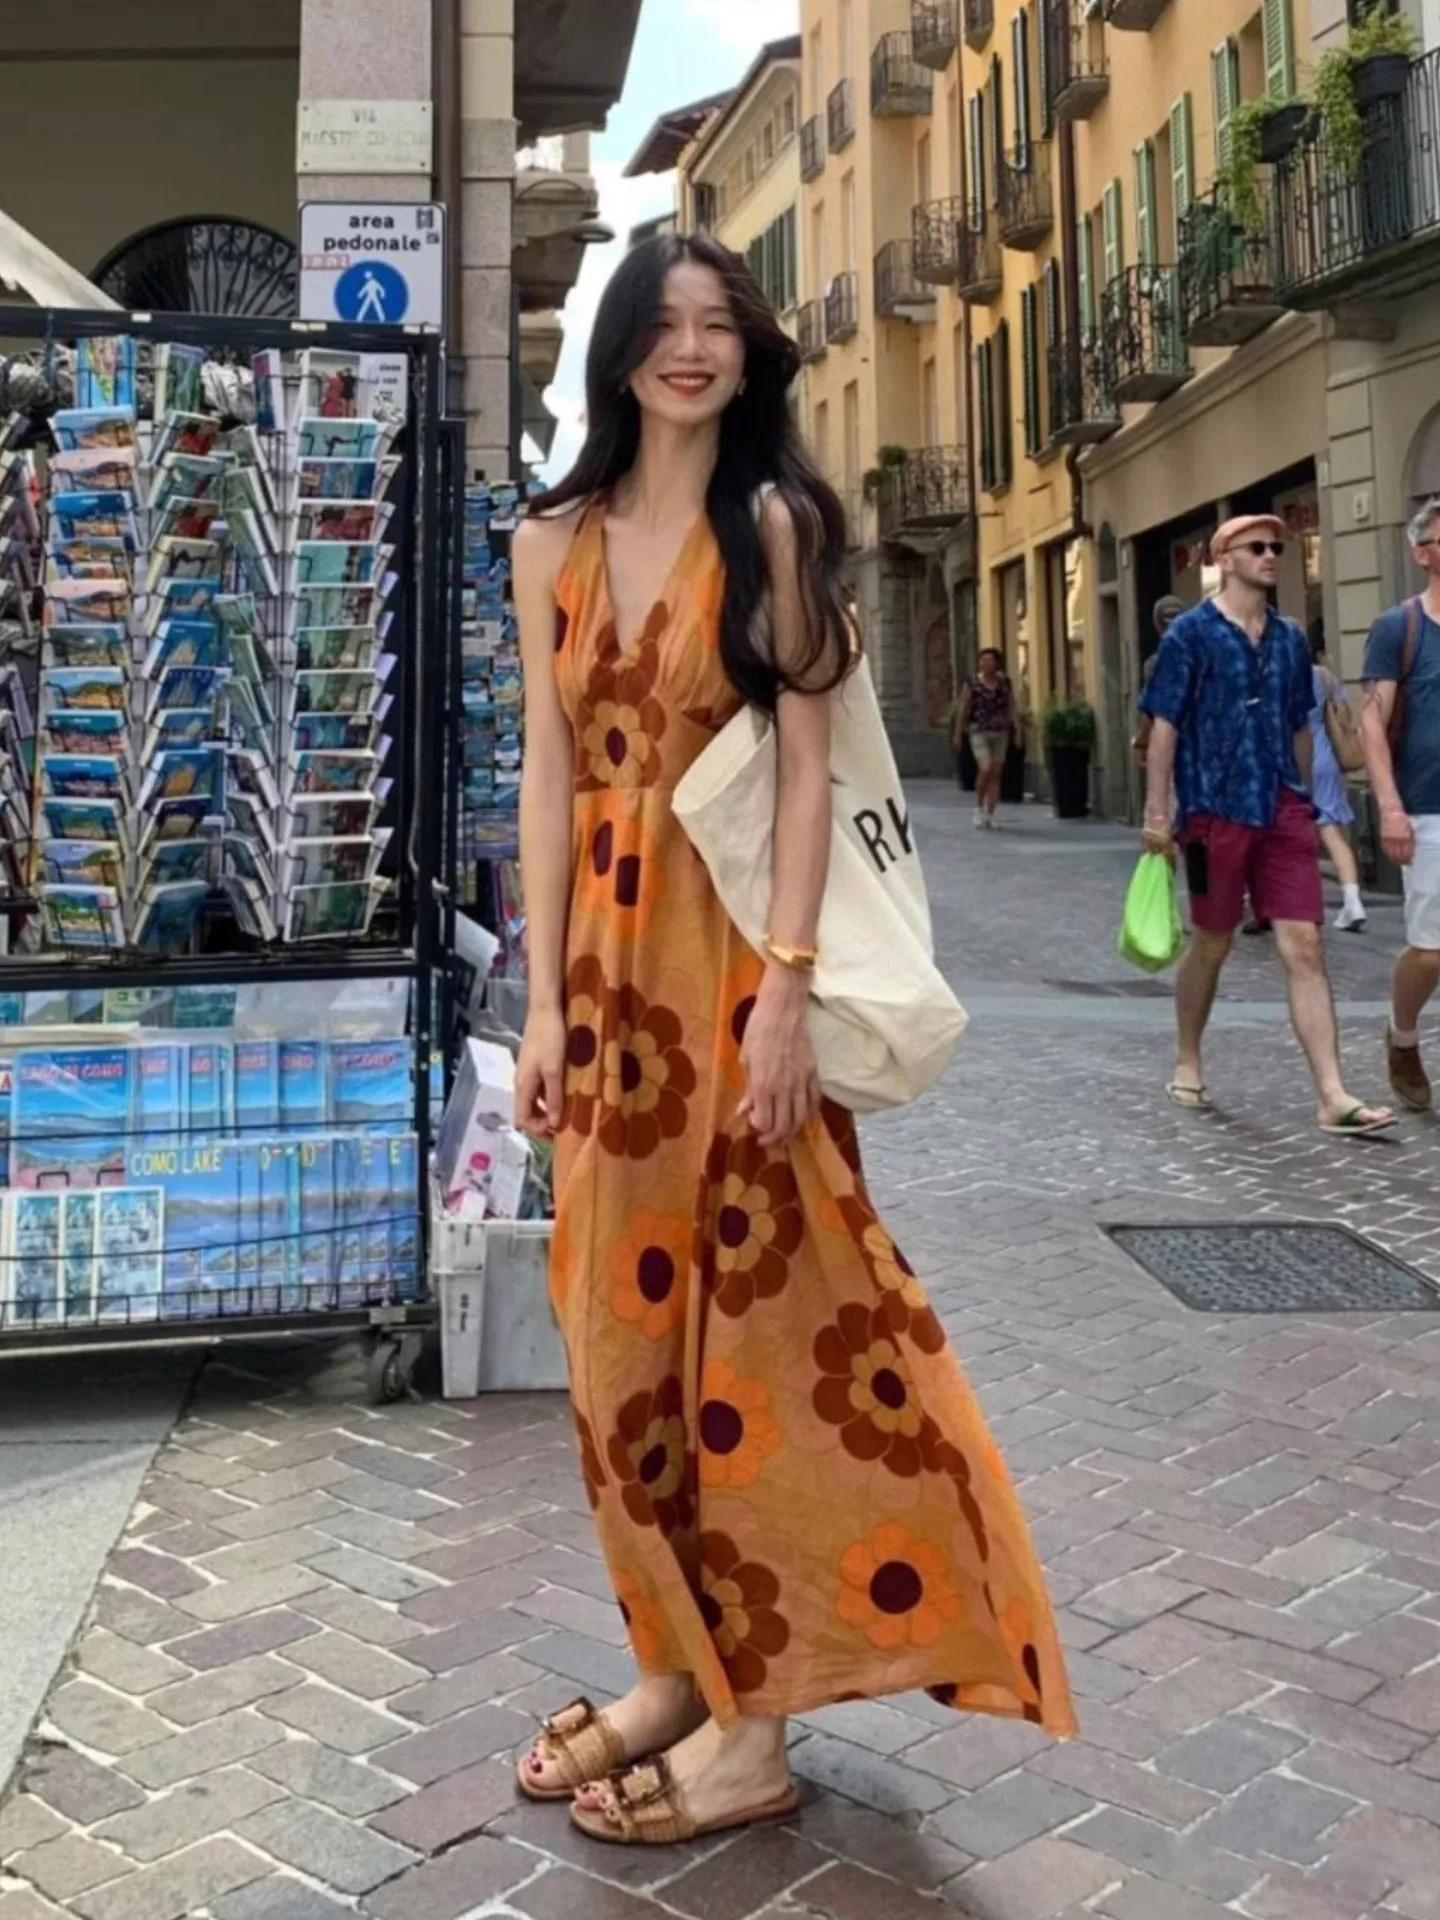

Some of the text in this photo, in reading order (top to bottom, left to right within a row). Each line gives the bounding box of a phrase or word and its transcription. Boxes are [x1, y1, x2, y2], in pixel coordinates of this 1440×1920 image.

[349, 215, 394, 229] area
[323, 234, 421, 252] pedonale
[131, 1148, 221, 1177] COMO LAKE
